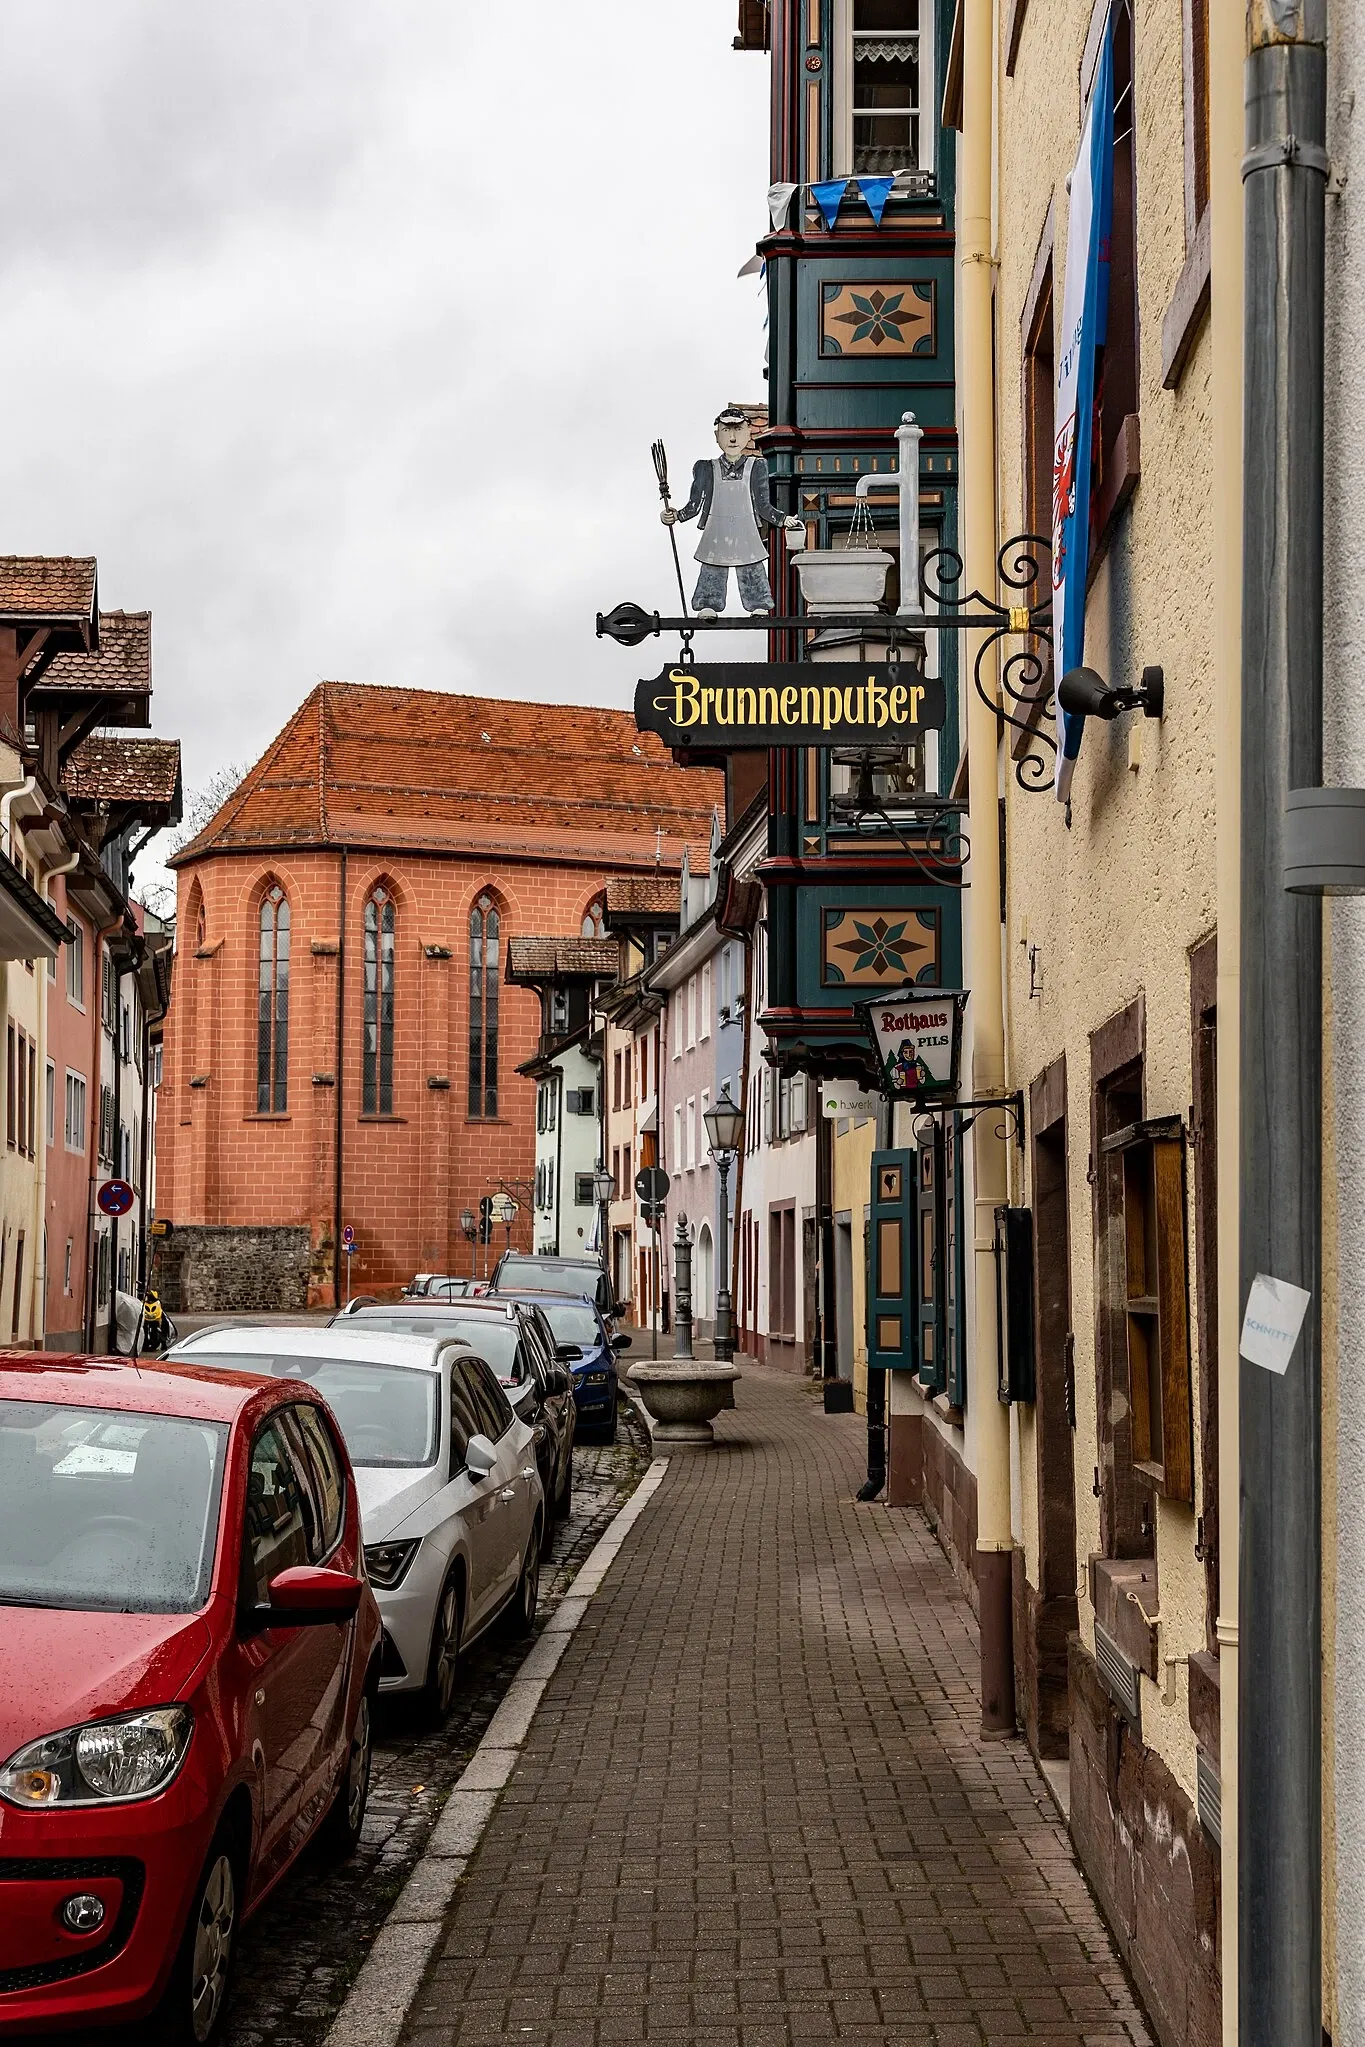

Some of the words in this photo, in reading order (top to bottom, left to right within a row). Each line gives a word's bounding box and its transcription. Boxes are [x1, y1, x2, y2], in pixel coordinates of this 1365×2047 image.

[652, 668, 925, 730] Brunnenputzer
[881, 1012, 948, 1033] Rothaus
[917, 1035, 949, 1047] PILS
[840, 1099, 873, 1110] h_werk
